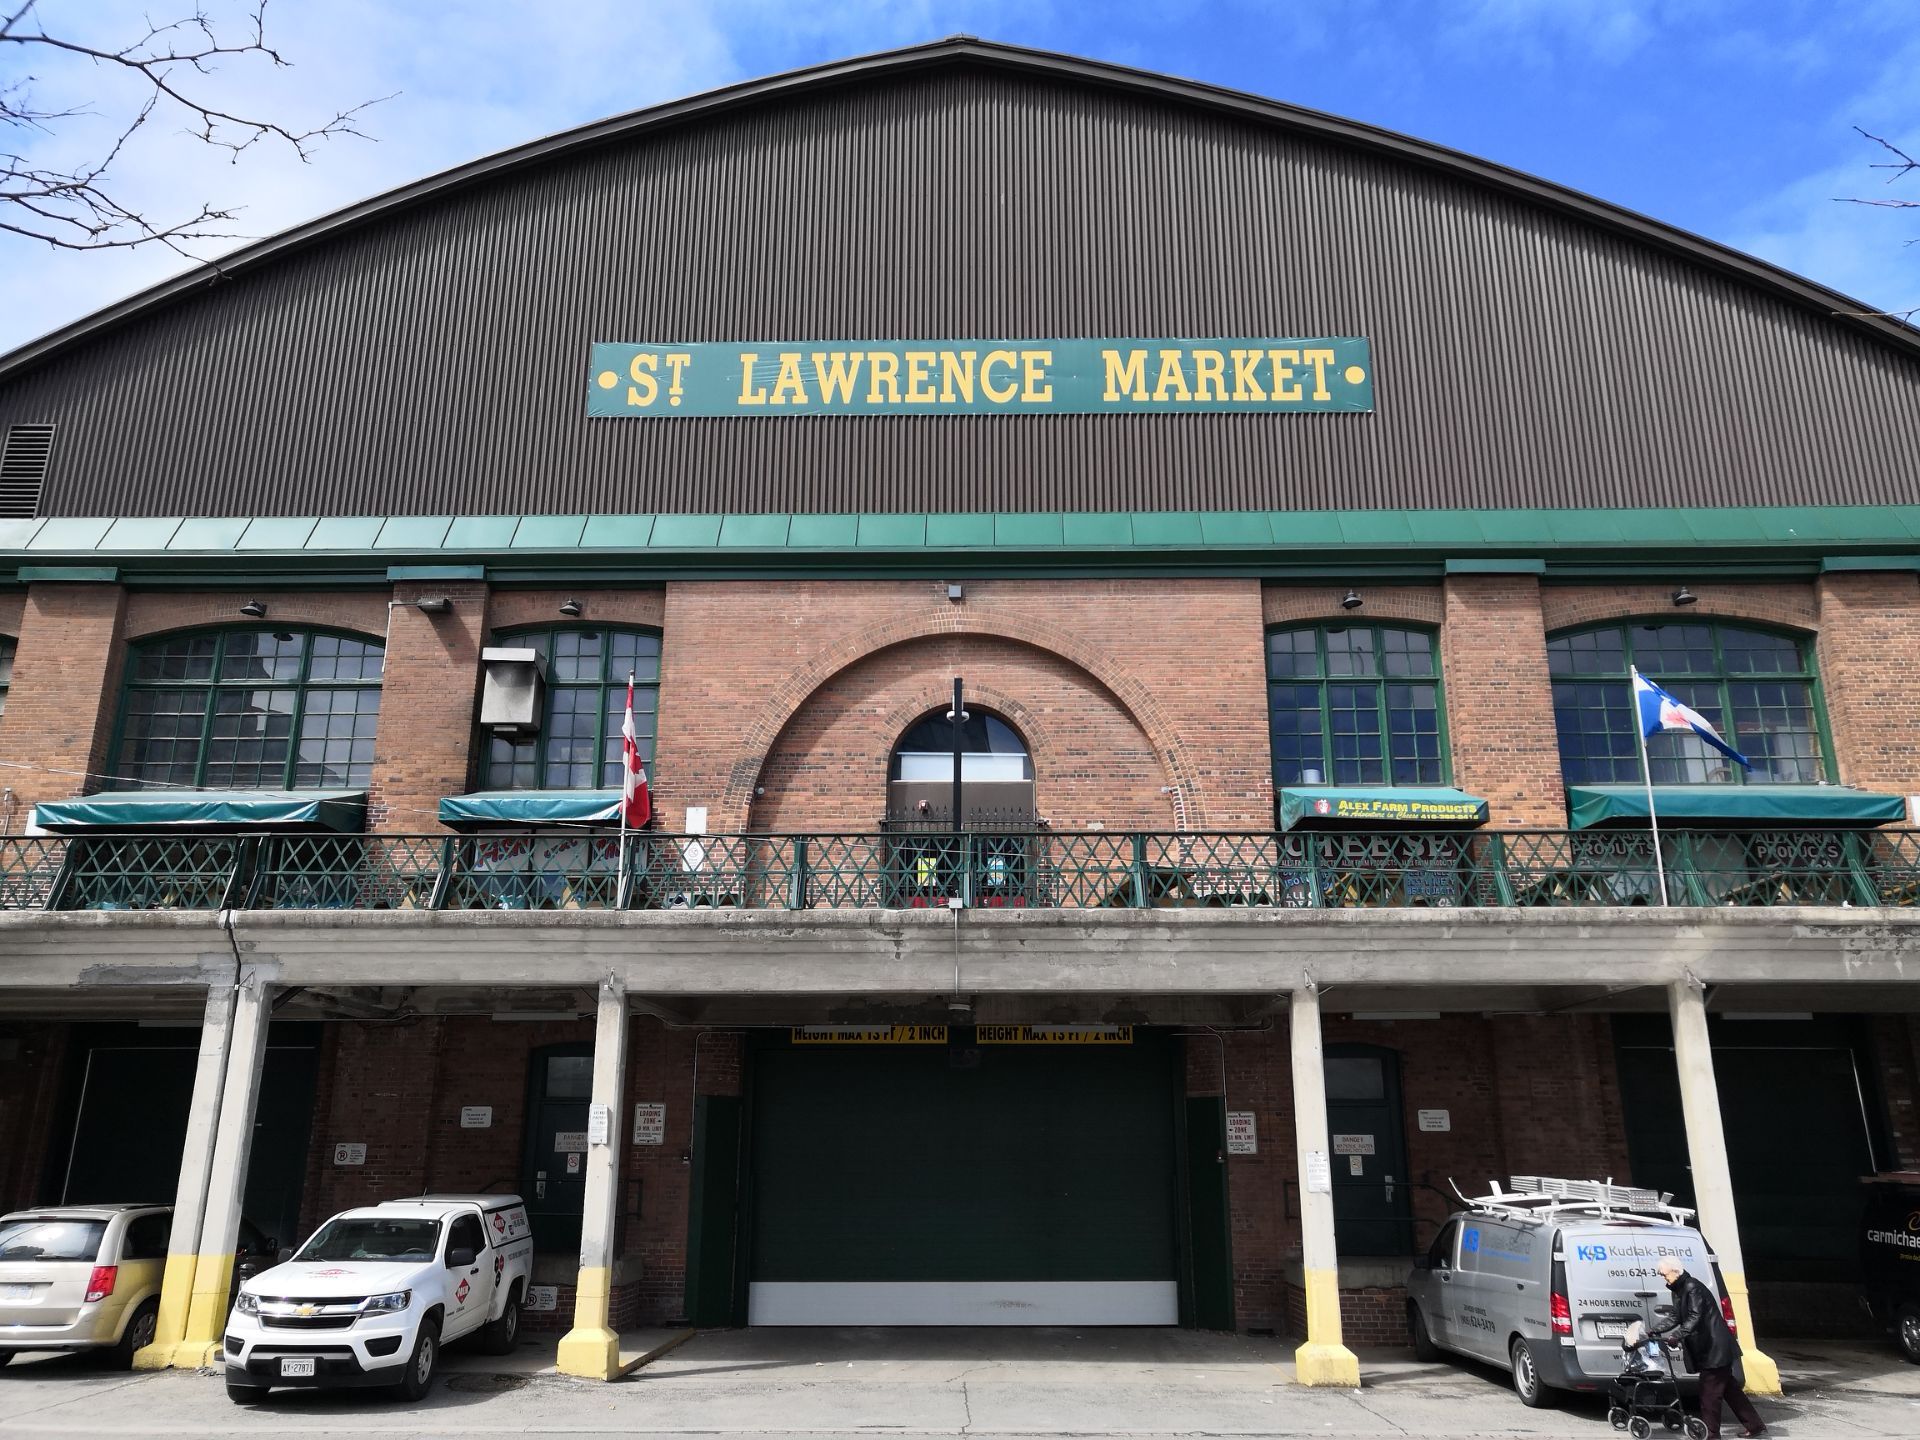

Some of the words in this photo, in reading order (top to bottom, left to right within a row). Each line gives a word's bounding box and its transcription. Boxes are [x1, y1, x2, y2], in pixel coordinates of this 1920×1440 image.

[738, 350, 1053, 406] LAWRENCE
[1103, 348, 1336, 403] MARKET
[1338, 800, 1369, 810] ALEX
[1373, 801, 1408, 812] FARM
[1411, 802, 1477, 813] PRODUCTS
[908, 1026, 916, 1041] 2
[919, 1026, 945, 1041] INCH
[978, 1026, 1020, 1041] HEIGHT
[1609, 1245, 1693, 1259] Kudlak-Baird
[1607, 1269, 1628, 1278] (905)
[1578, 1299, 1588, 1307] 24
[1590, 1299, 1610, 1307] HOUR
[1610, 1299, 1643, 1308] SERVICE
